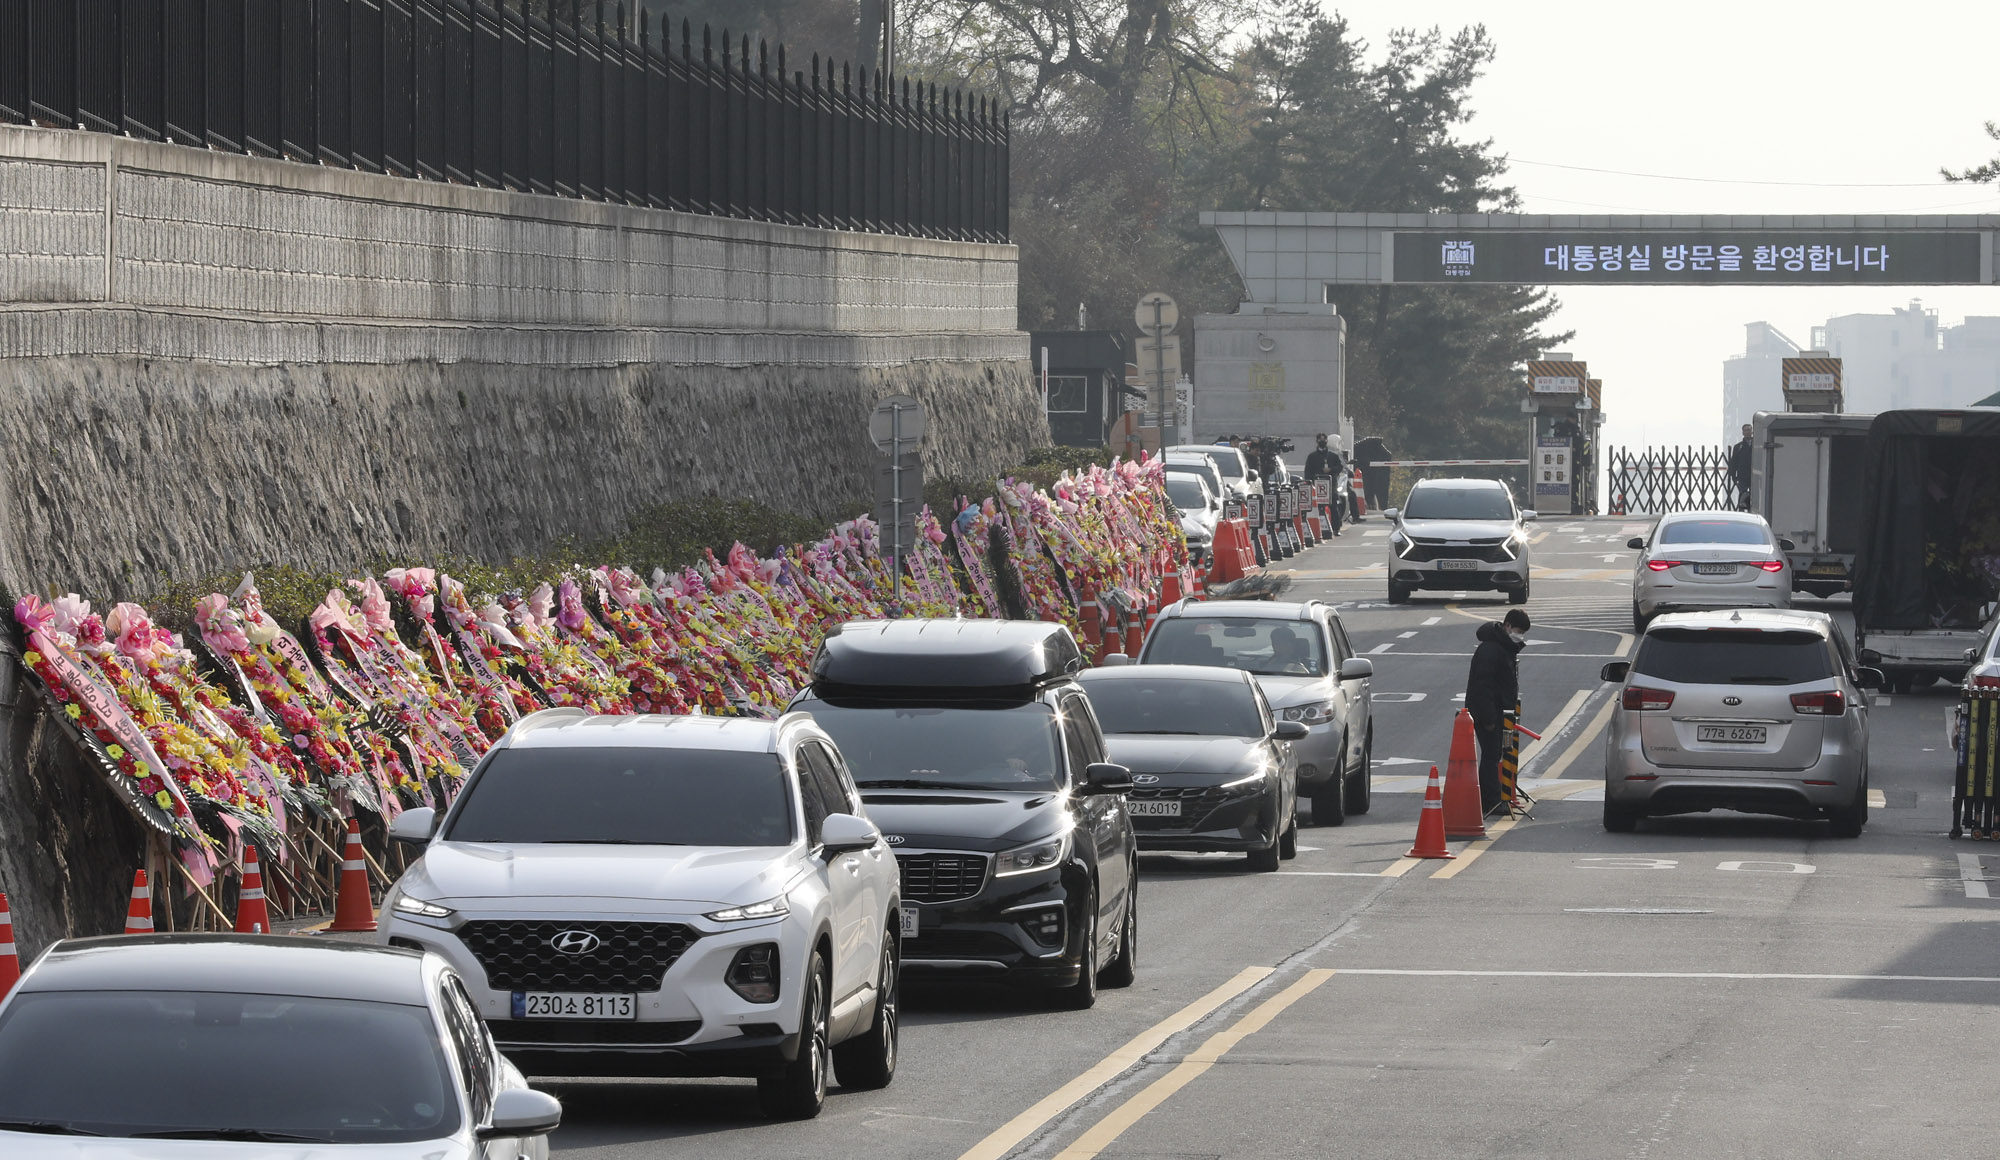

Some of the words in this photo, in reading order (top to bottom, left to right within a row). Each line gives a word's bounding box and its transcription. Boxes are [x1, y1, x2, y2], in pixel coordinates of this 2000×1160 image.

[1544, 245, 1650, 271] 대통령실
[1662, 245, 1743, 271] 방문을
[1753, 245, 1889, 271] 환영합니다
[968, 562, 984, 586] 양주
[1730, 727, 1760, 740] 6267
[1150, 802, 1178, 814] 6019
[527, 996, 577, 1015] 230소
[583, 996, 630, 1016] 8113
